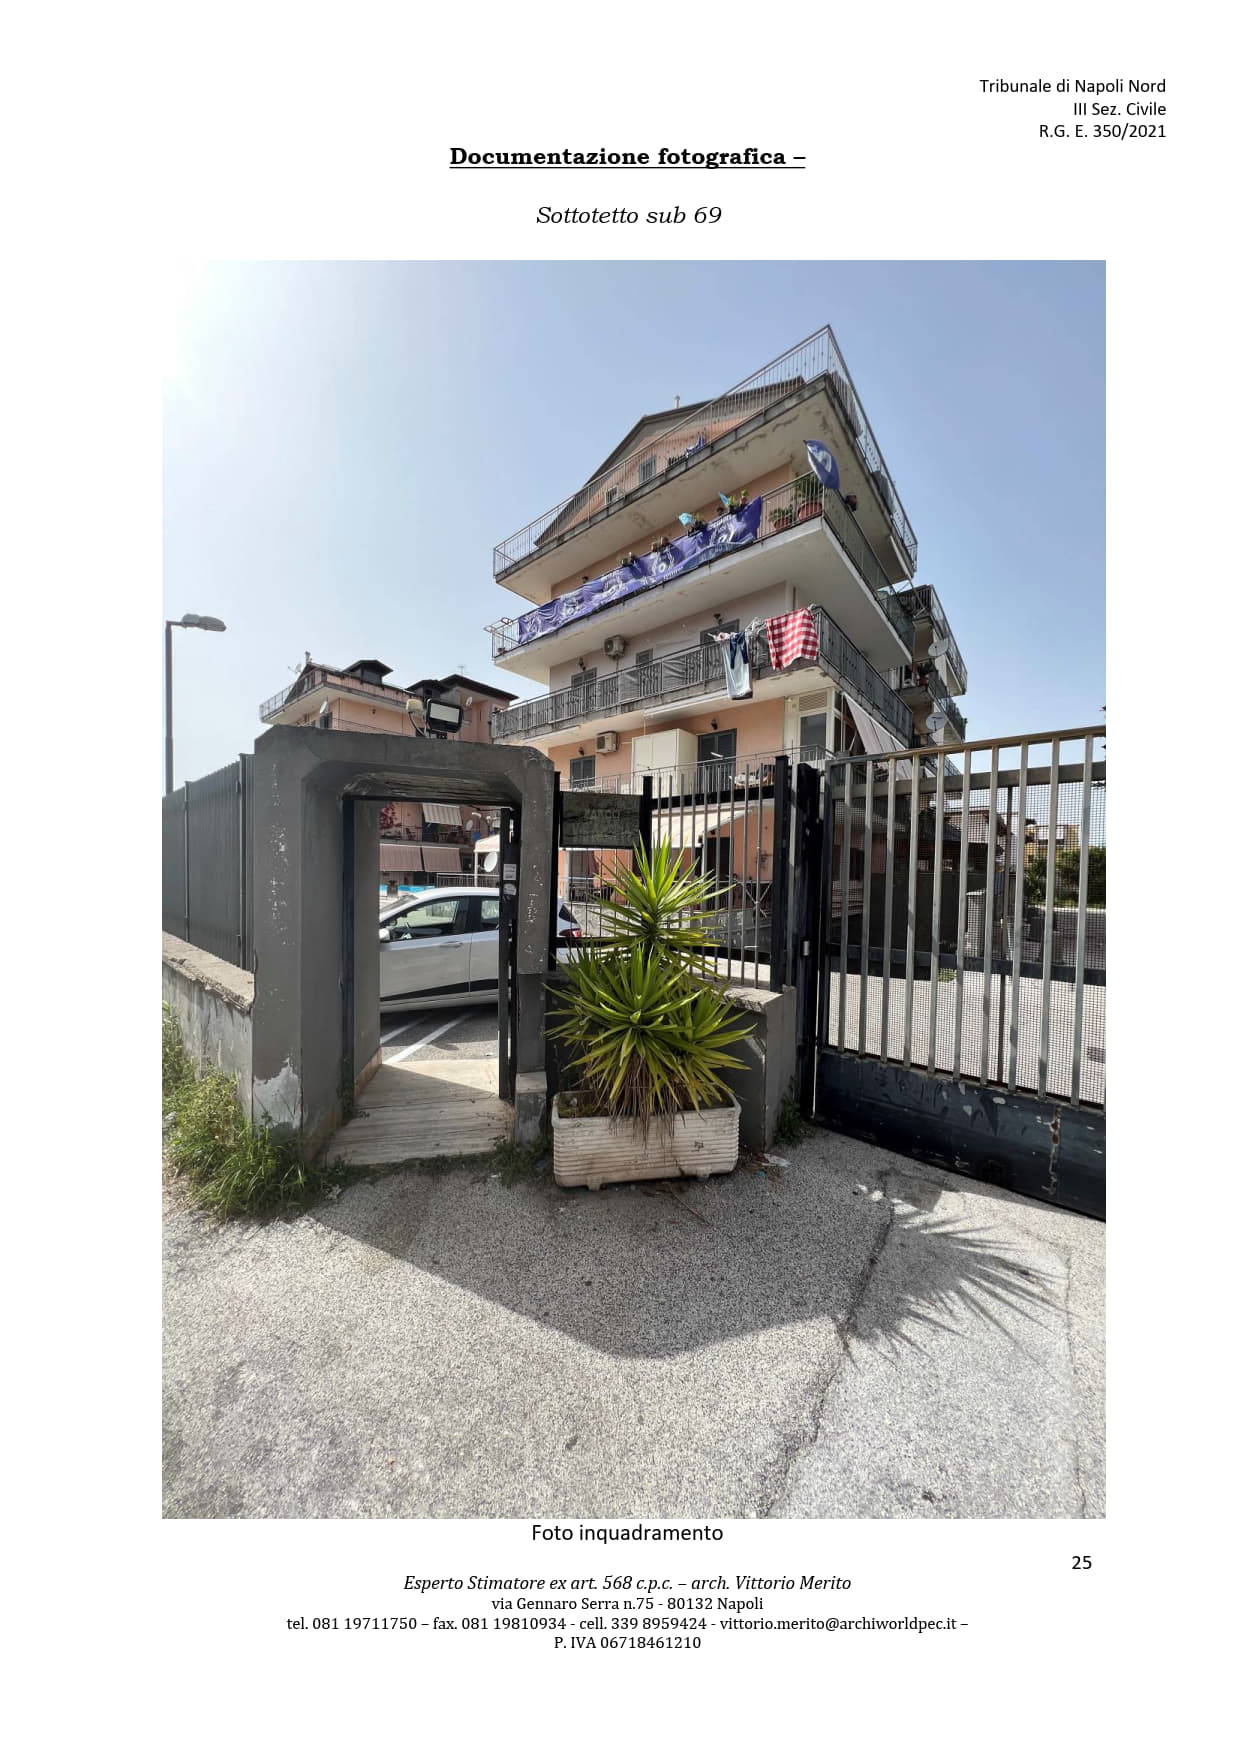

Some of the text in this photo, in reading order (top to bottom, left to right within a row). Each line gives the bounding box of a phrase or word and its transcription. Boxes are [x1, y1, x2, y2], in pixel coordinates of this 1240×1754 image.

[980, 79, 1165, 95] Tribunale di Napoli Nord
[1075, 102, 1166, 115] III Sez. Civile
[1040, 123, 1166, 140] R.G. E. 350/2021
[449, 147, 650, 165] Documentazione
[657, 147, 787, 169] fotografica
[536, 206, 721, 223] Sottotetto sub 69
[533, 1524, 723, 1544] Foto inquadramento
[1072, 1556, 1091, 1569] 25
[404, 1576, 463, 1593] Esperto
[468, 1576, 545, 1589] Stimatore
[550, 1580, 567, 1589] ex
[571, 1578, 597, 1589] art.
[603, 1576, 632, 1589] 568
[637, 1580, 672, 1593] c.p.c.
[692, 1576, 729, 1589] arch.
[736, 1576, 794, 1589] Vittorio
[800, 1576, 851, 1589] Merito
[492, 1598, 512, 1609] via
[517, 1598, 577, 1609] Gennaro
[582, 1598, 619, 1609] Serra
[624, 1598, 653, 1609] n.75
[668, 1598, 712, 1609] 80132
[718, 1597, 763, 1613] Napoli
[287, 1617, 308, 1629] tel.
[313, 1618, 338, 1629] 081
[345, 1618, 416, 1629] 19711750
[434, 1617, 457, 1629] fax.
[462, 1618, 488, 1629] 081
[494, 1618, 566, 1629] 19810934
[580, 1617, 606, 1629] cell.
[612, 1618, 638, 1629] 339
[643, 1618, 707, 1629] 8959424
[720, 1617, 957, 1633] vittorio.merito@archiworldpec.it
[555, 1637, 701, 1648] P. IVA 06718461210
